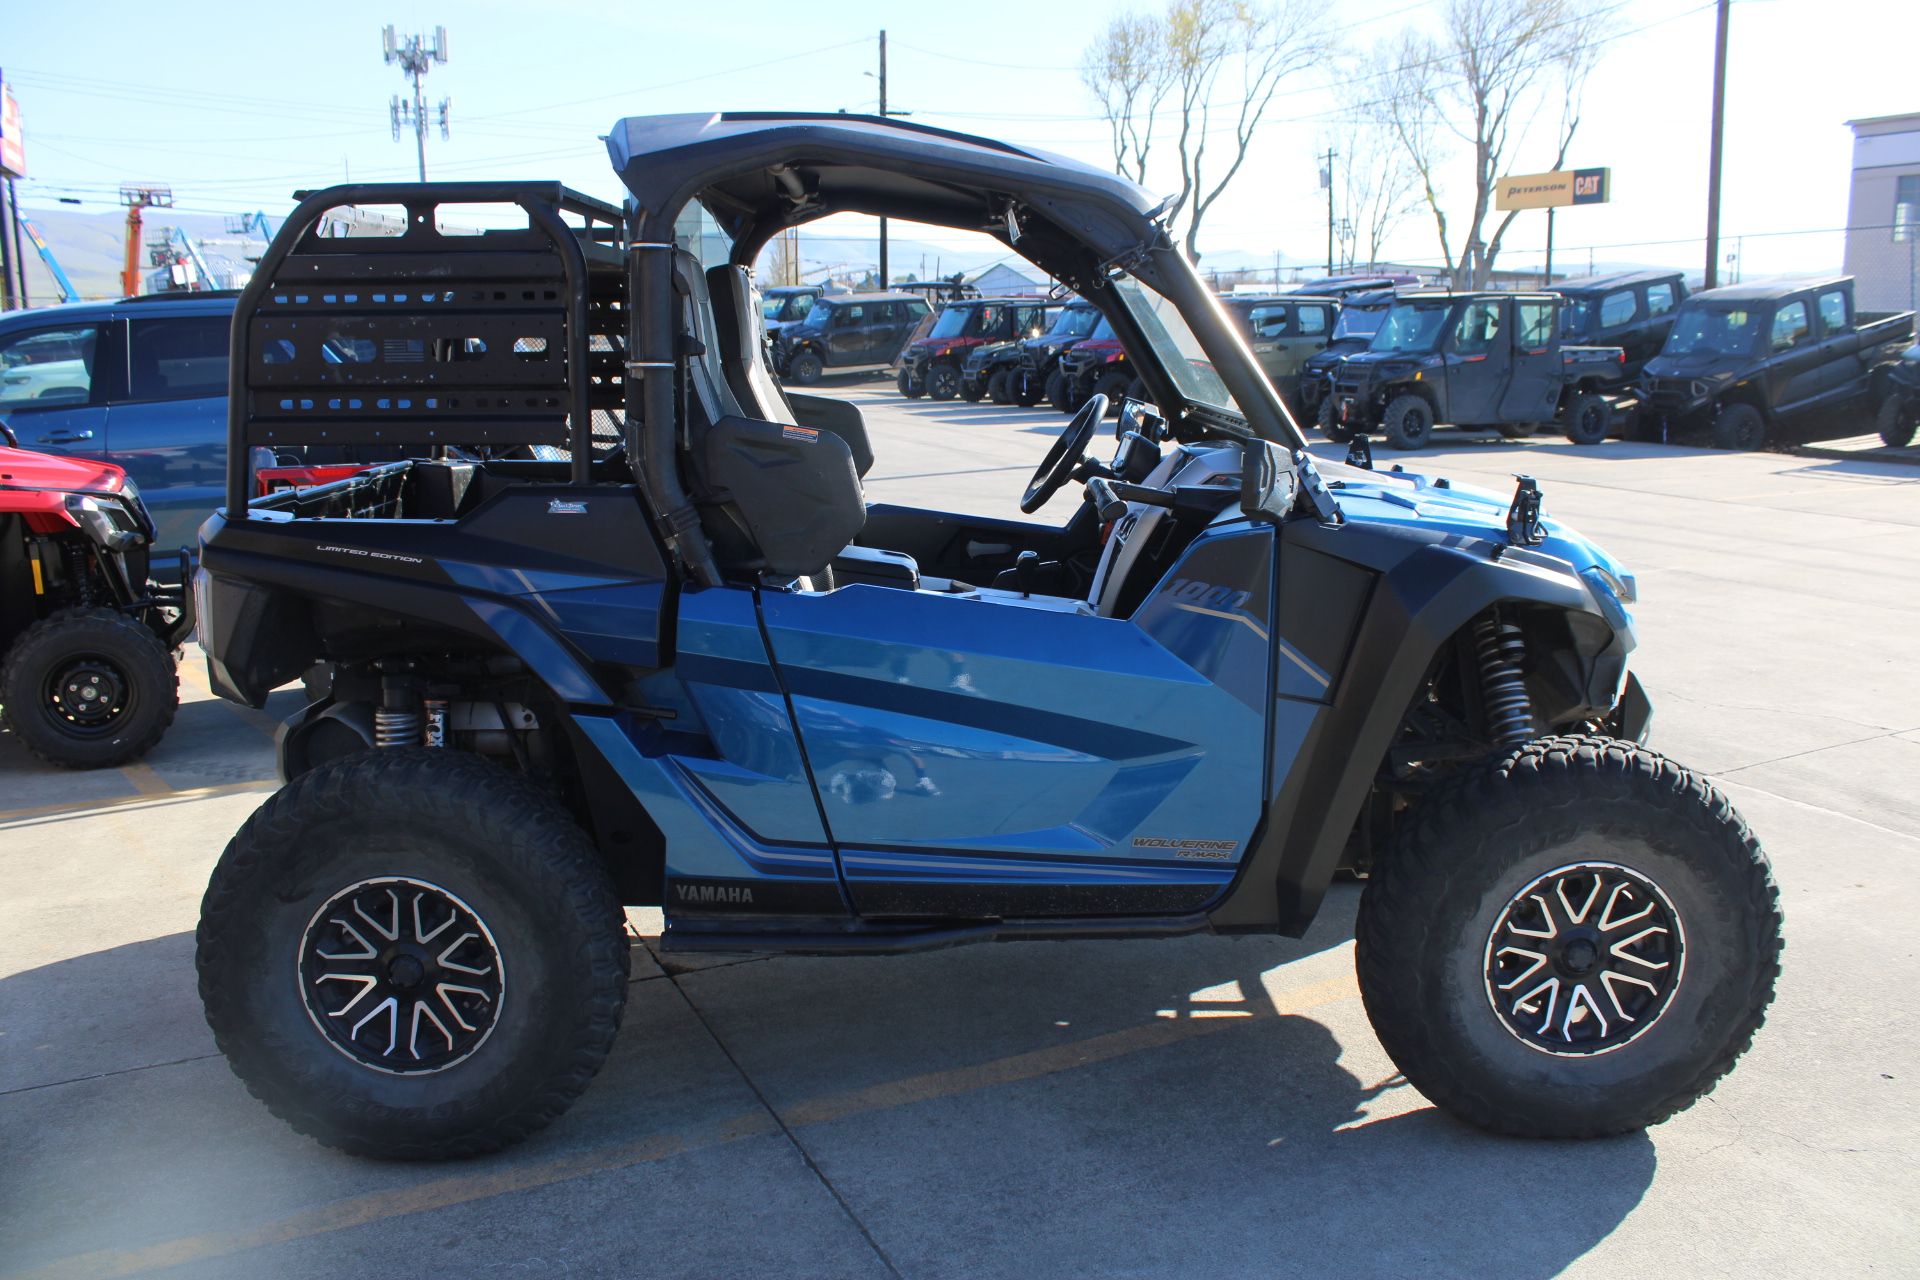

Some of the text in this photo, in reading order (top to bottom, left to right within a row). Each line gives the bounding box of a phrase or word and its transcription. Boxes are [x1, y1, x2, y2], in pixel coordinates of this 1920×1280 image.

[1507, 175, 1600, 199] PETERSON CAT
[316, 545, 423, 563] LIMITED EDITION
[676, 884, 754, 903] YAMAHA
